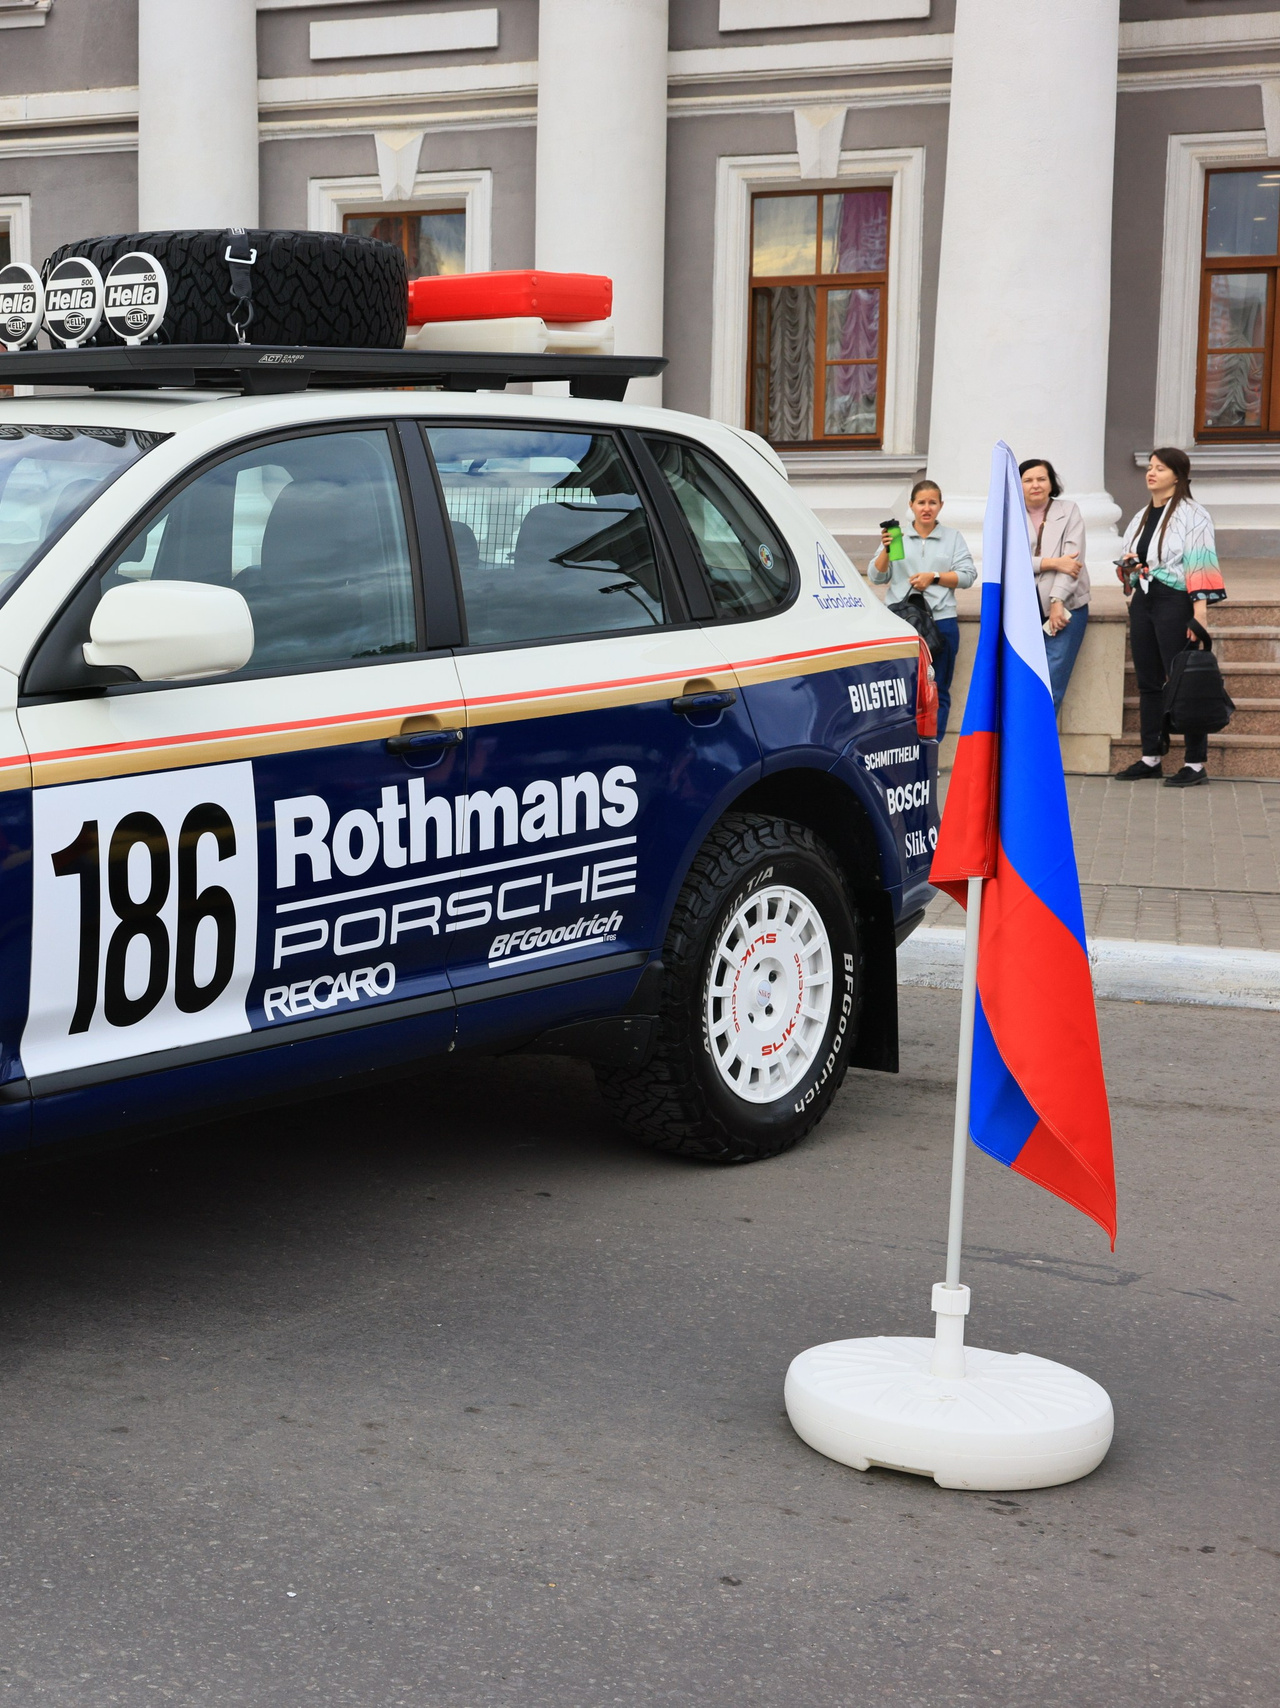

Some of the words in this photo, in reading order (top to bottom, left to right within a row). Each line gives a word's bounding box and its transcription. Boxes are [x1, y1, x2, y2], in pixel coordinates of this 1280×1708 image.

[81, 278, 94, 286] 500
[143, 274, 157, 282] 500
[47, 288, 94, 311] Hella
[107, 284, 157, 307] Hella
[7, 321, 26, 330] HELLA
[66, 317, 86, 326] HELLA
[126, 313, 149, 323] HELLA
[813, 593, 865, 610] Turbolader
[848, 678, 908, 713] BILSTEIN
[864, 744, 920, 771] SCHMITTHELM
[886, 780, 930, 816] BOSCH
[273, 765, 639, 889] Rothmans
[905, 829, 928, 859] Slik
[746, 866, 774, 893] T/A
[51, 802, 237, 1035] 186
[272, 855, 638, 970] PORSCHE
[488, 909, 624, 959] BFGoodrich
[603, 933, 617, 941] Tires
[263, 962, 396, 1021] RECARO
[794, 952, 854, 1114] BFGoodrich
